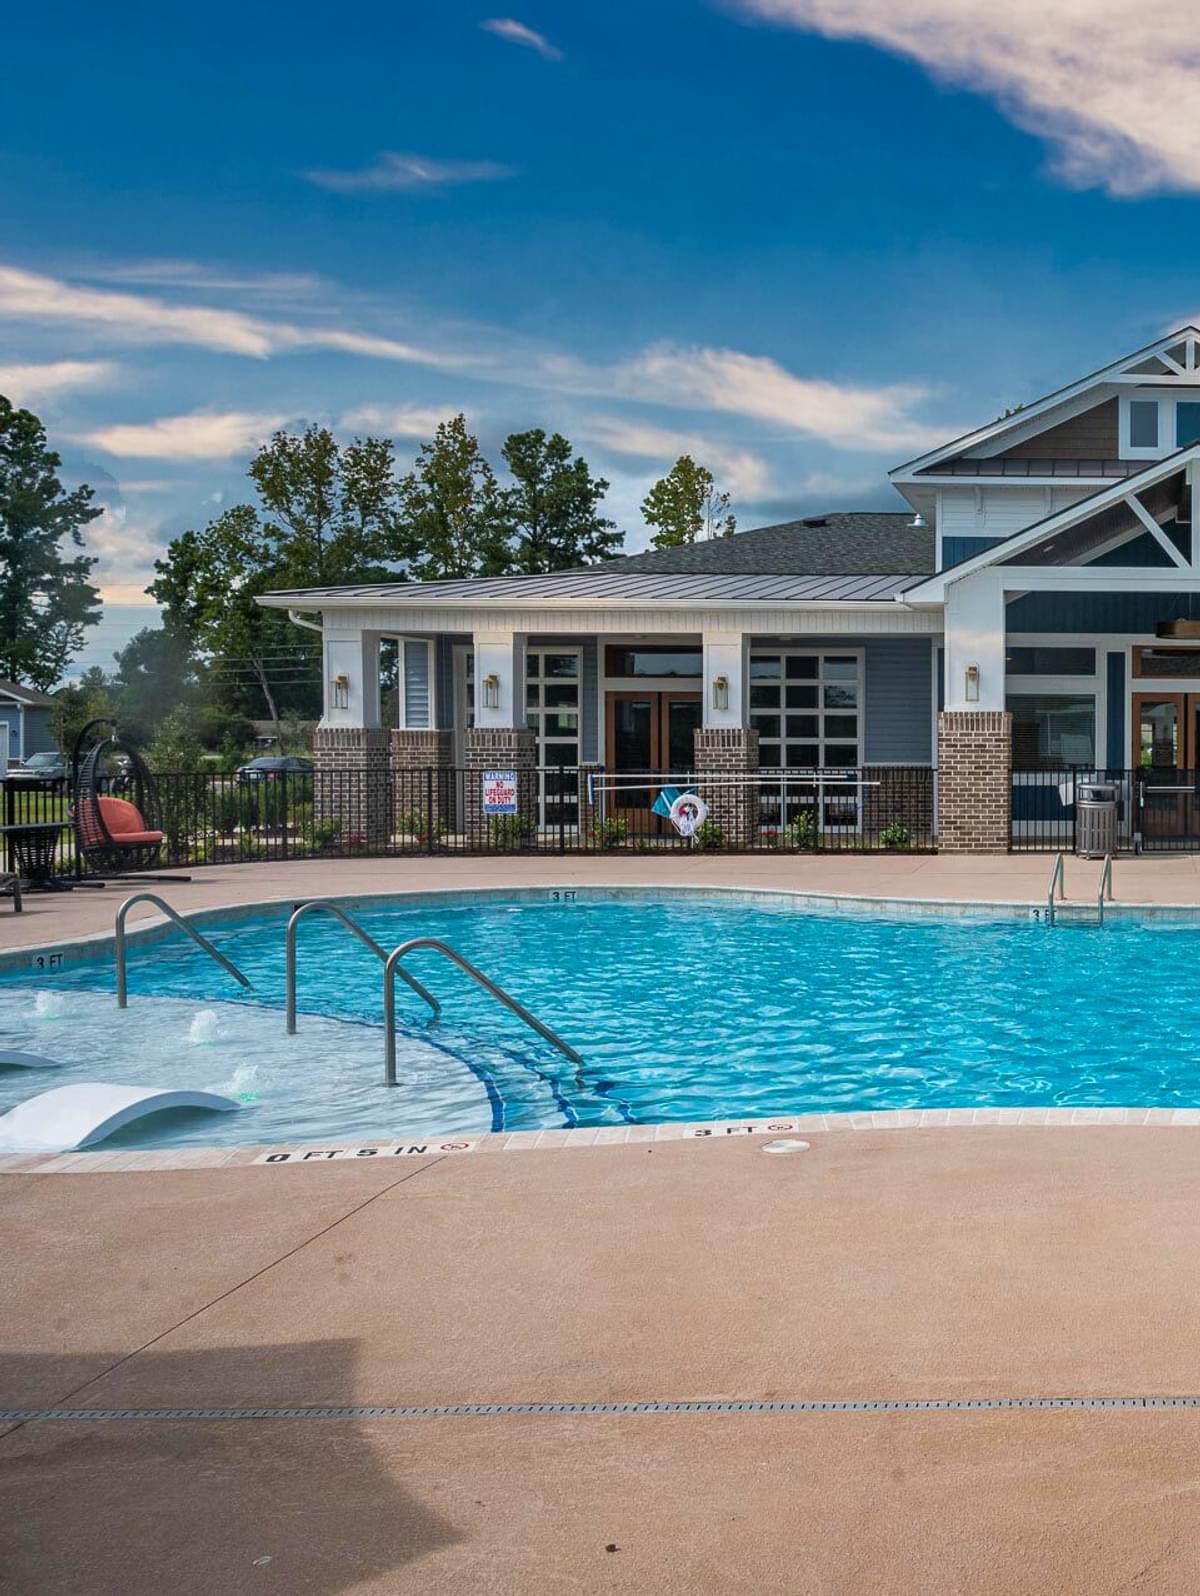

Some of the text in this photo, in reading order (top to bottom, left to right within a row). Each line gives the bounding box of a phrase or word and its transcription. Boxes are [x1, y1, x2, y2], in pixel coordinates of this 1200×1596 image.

[496, 781, 504, 789] NO
[552, 891, 577, 903] 3 FT
[36, 953, 63, 969] 3 FT
[694, 1126, 758, 1137] 3 FT
[265, 1146, 428, 1163] 0 FT 5 IN
